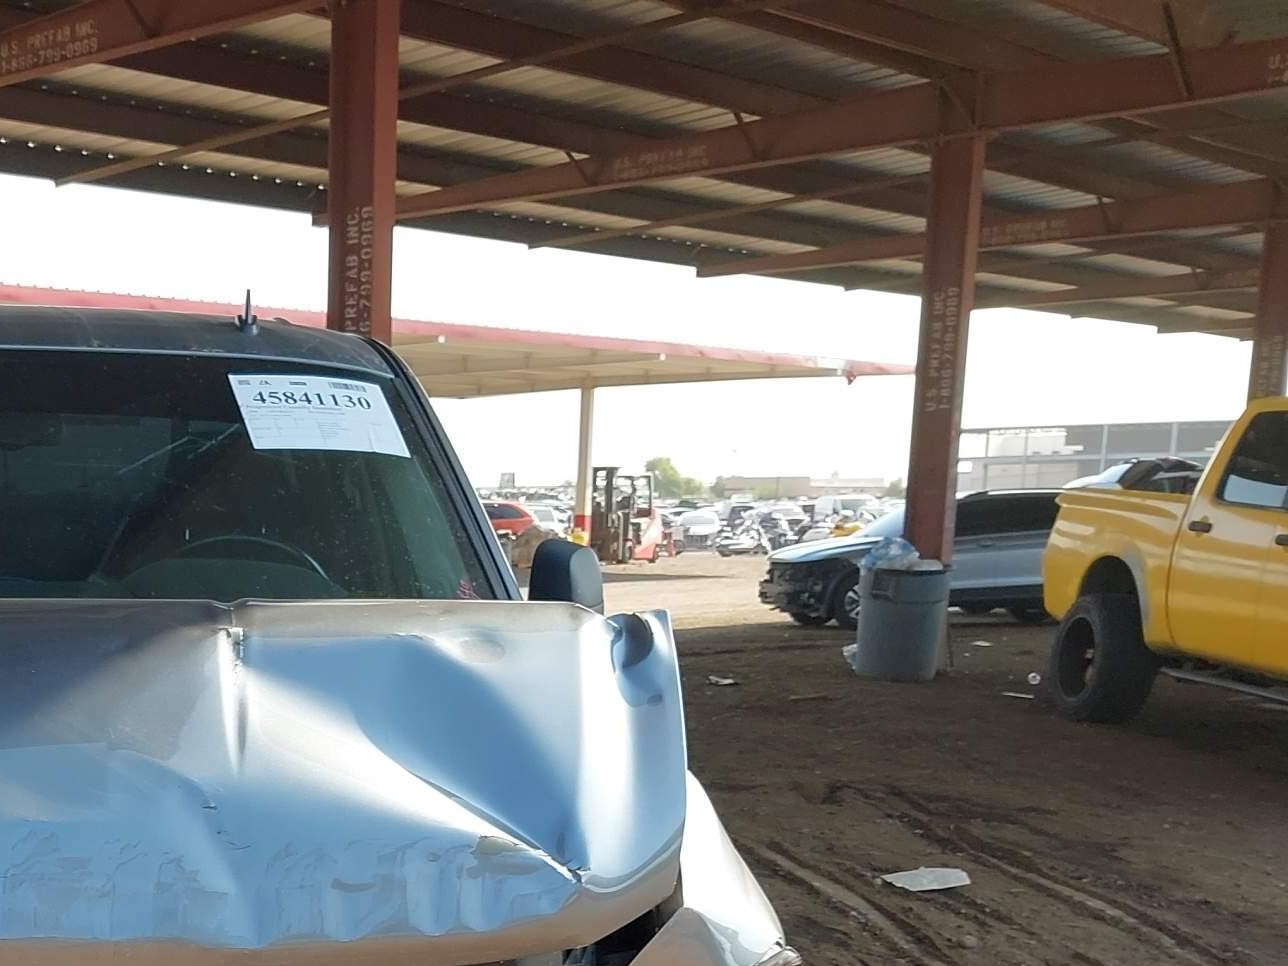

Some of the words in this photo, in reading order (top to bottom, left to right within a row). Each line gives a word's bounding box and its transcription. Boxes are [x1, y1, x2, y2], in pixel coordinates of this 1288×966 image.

[27, 24, 72, 50] PREFAB
[346, 206, 360, 244] INC.
[344, 255, 359, 332] PREFAB
[252, 391, 372, 410] 45841130
